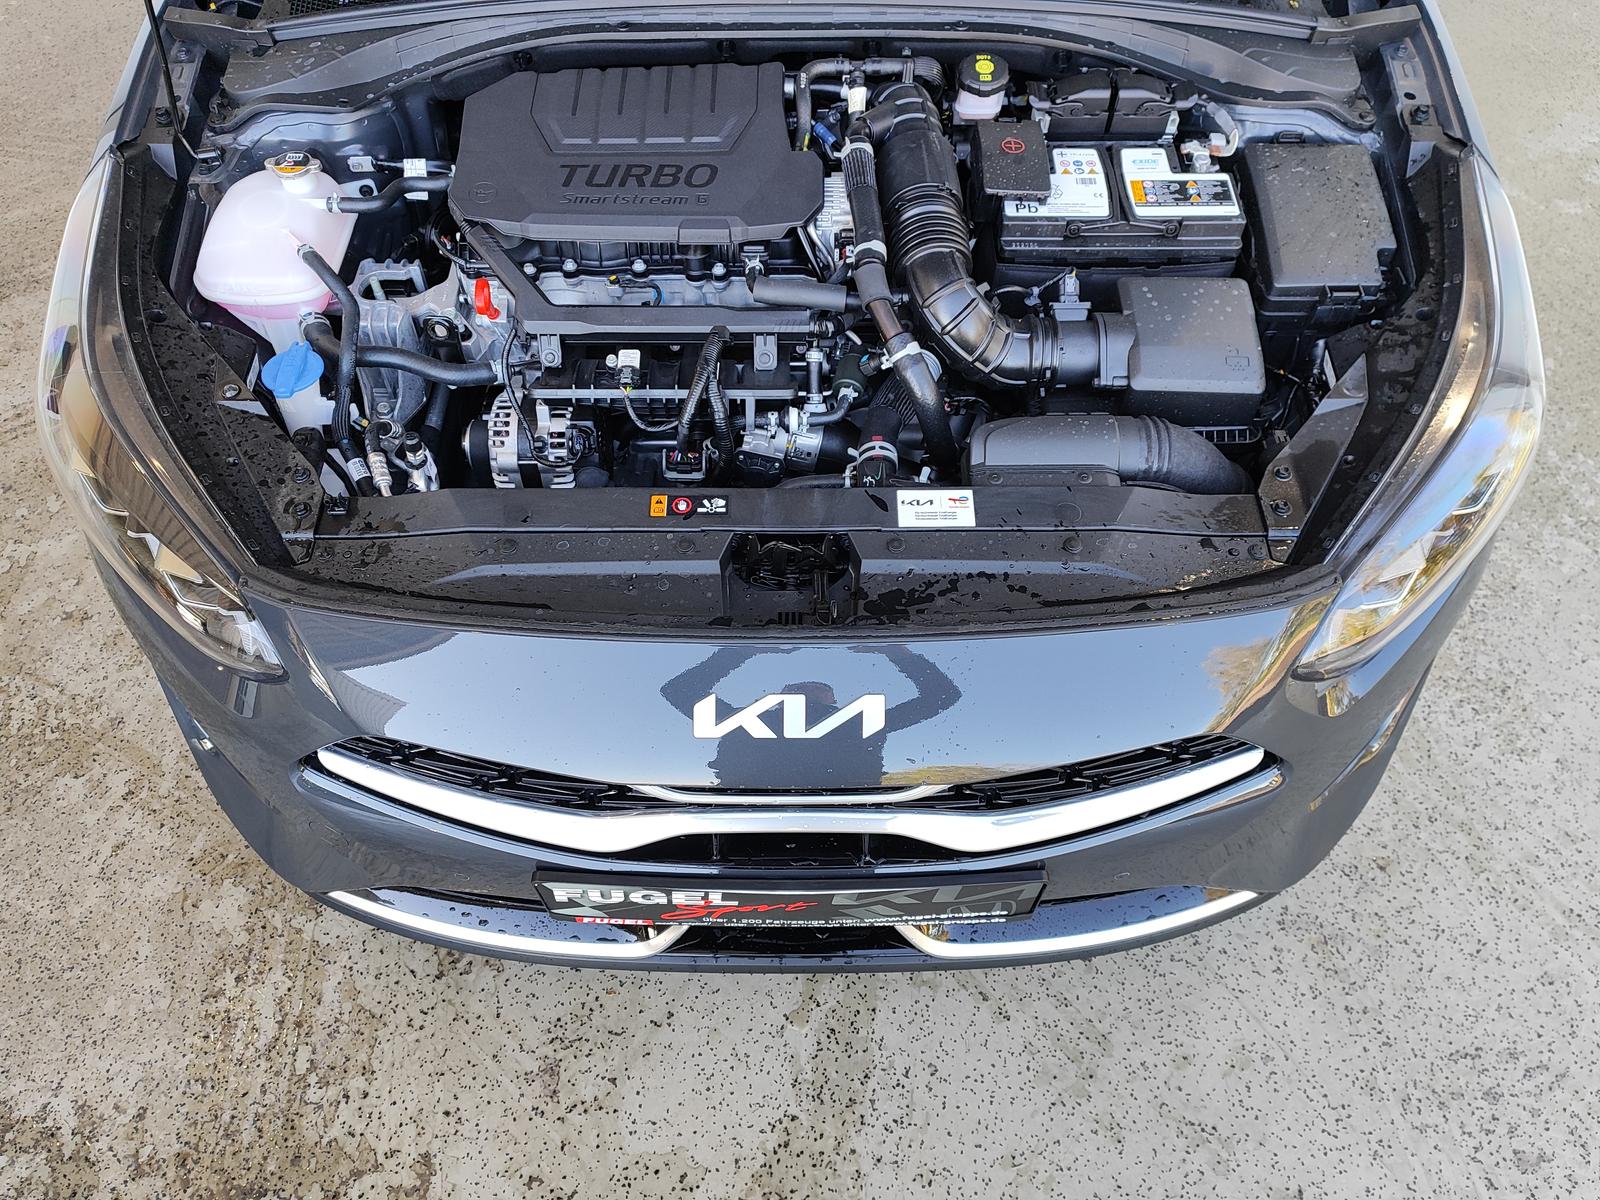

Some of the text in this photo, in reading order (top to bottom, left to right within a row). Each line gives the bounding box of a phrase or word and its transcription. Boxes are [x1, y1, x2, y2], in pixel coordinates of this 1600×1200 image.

[559, 163, 719, 188] TURBO
[559, 192, 689, 206] Smartstream
[1015, 203, 1039, 214] Pb
[901, 498, 934, 506] KIA
[693, 693, 886, 739] KIA
[552, 887, 739, 906] FUGEL
[660, 899, 818, 920] Sport
[765, 918, 826, 926] Fahrzeuge
[864, 910, 1009, 923] www.fugel-gruppe.de
